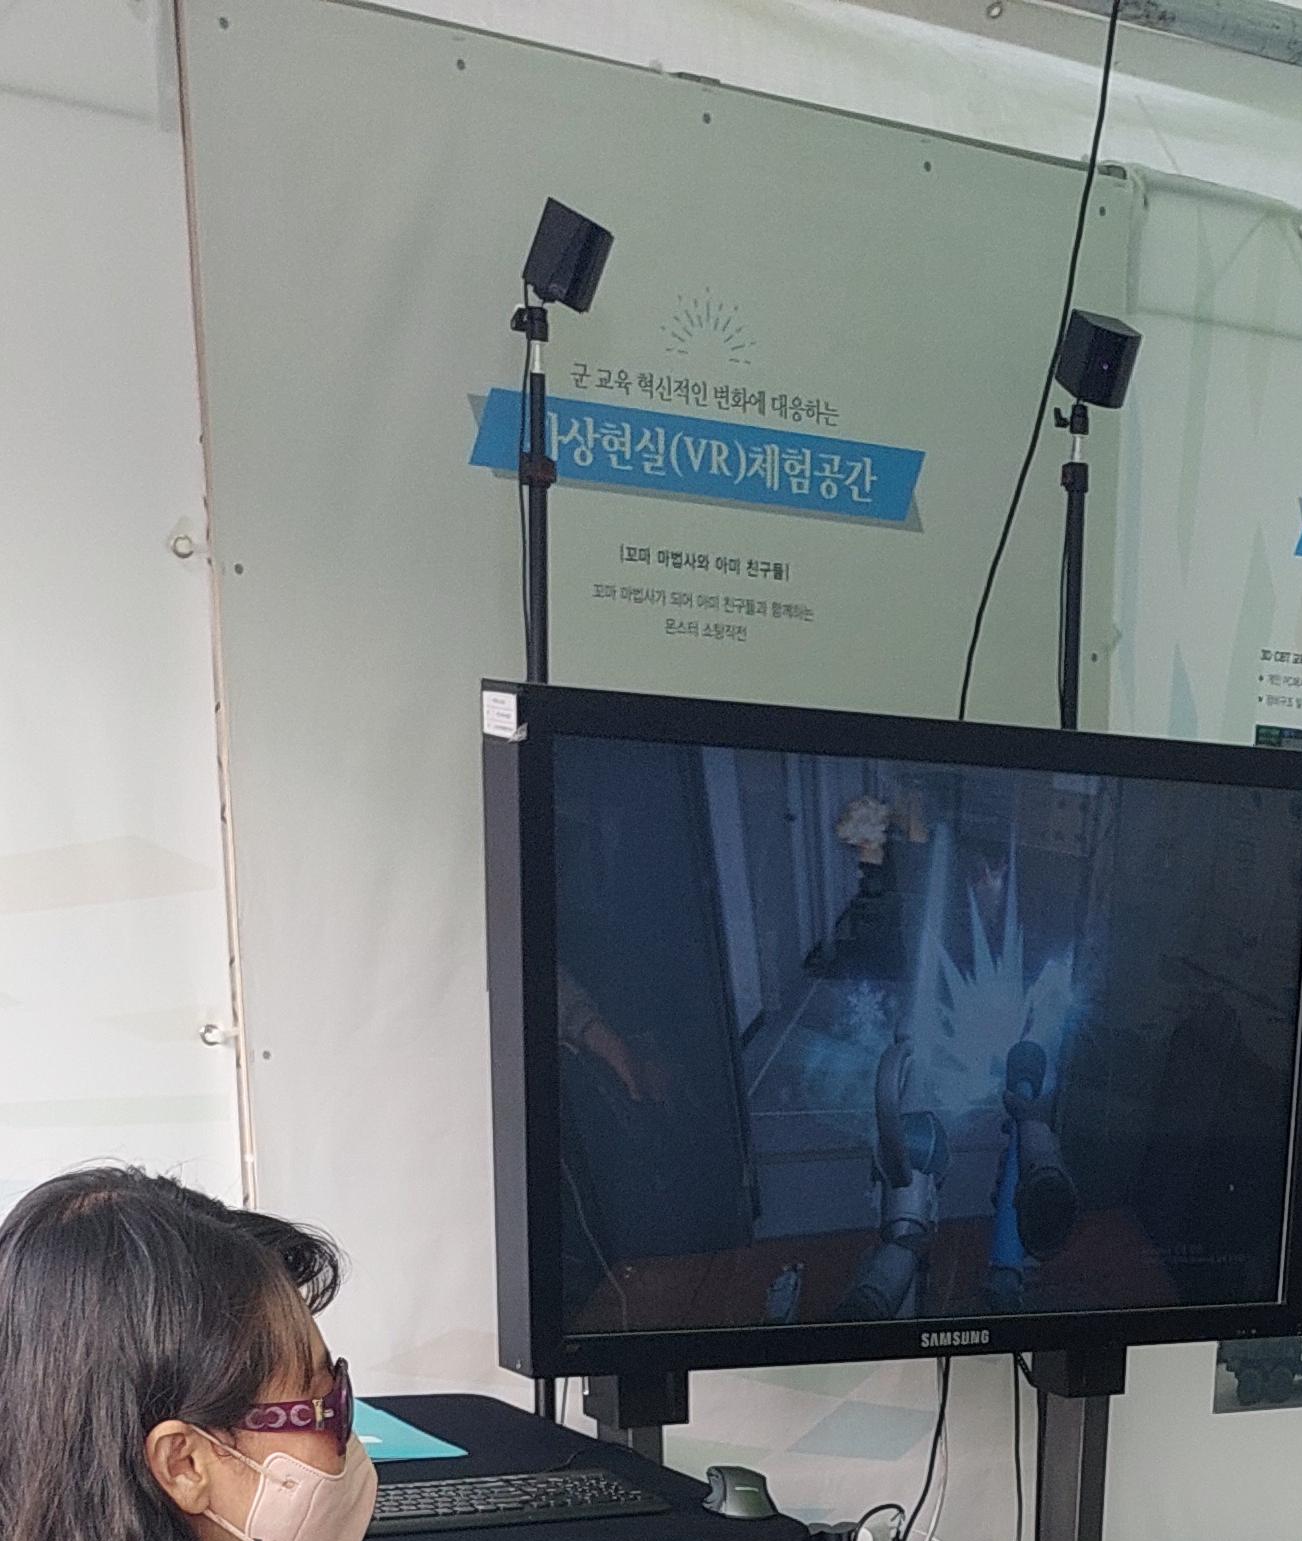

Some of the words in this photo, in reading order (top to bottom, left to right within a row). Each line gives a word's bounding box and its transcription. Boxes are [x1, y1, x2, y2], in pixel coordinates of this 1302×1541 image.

[571, 363, 591, 389] 군
[595, 368, 632, 395] 교육
[637, 373, 708, 407] 혁신적인
[713, 385, 766, 416] 변화에
[771, 395, 841, 427] 대응하는
[657, 550, 710, 572] 마법사와
[715, 556, 741, 575] 아미
[920, 1329, 990, 1348] SAMSUNG
